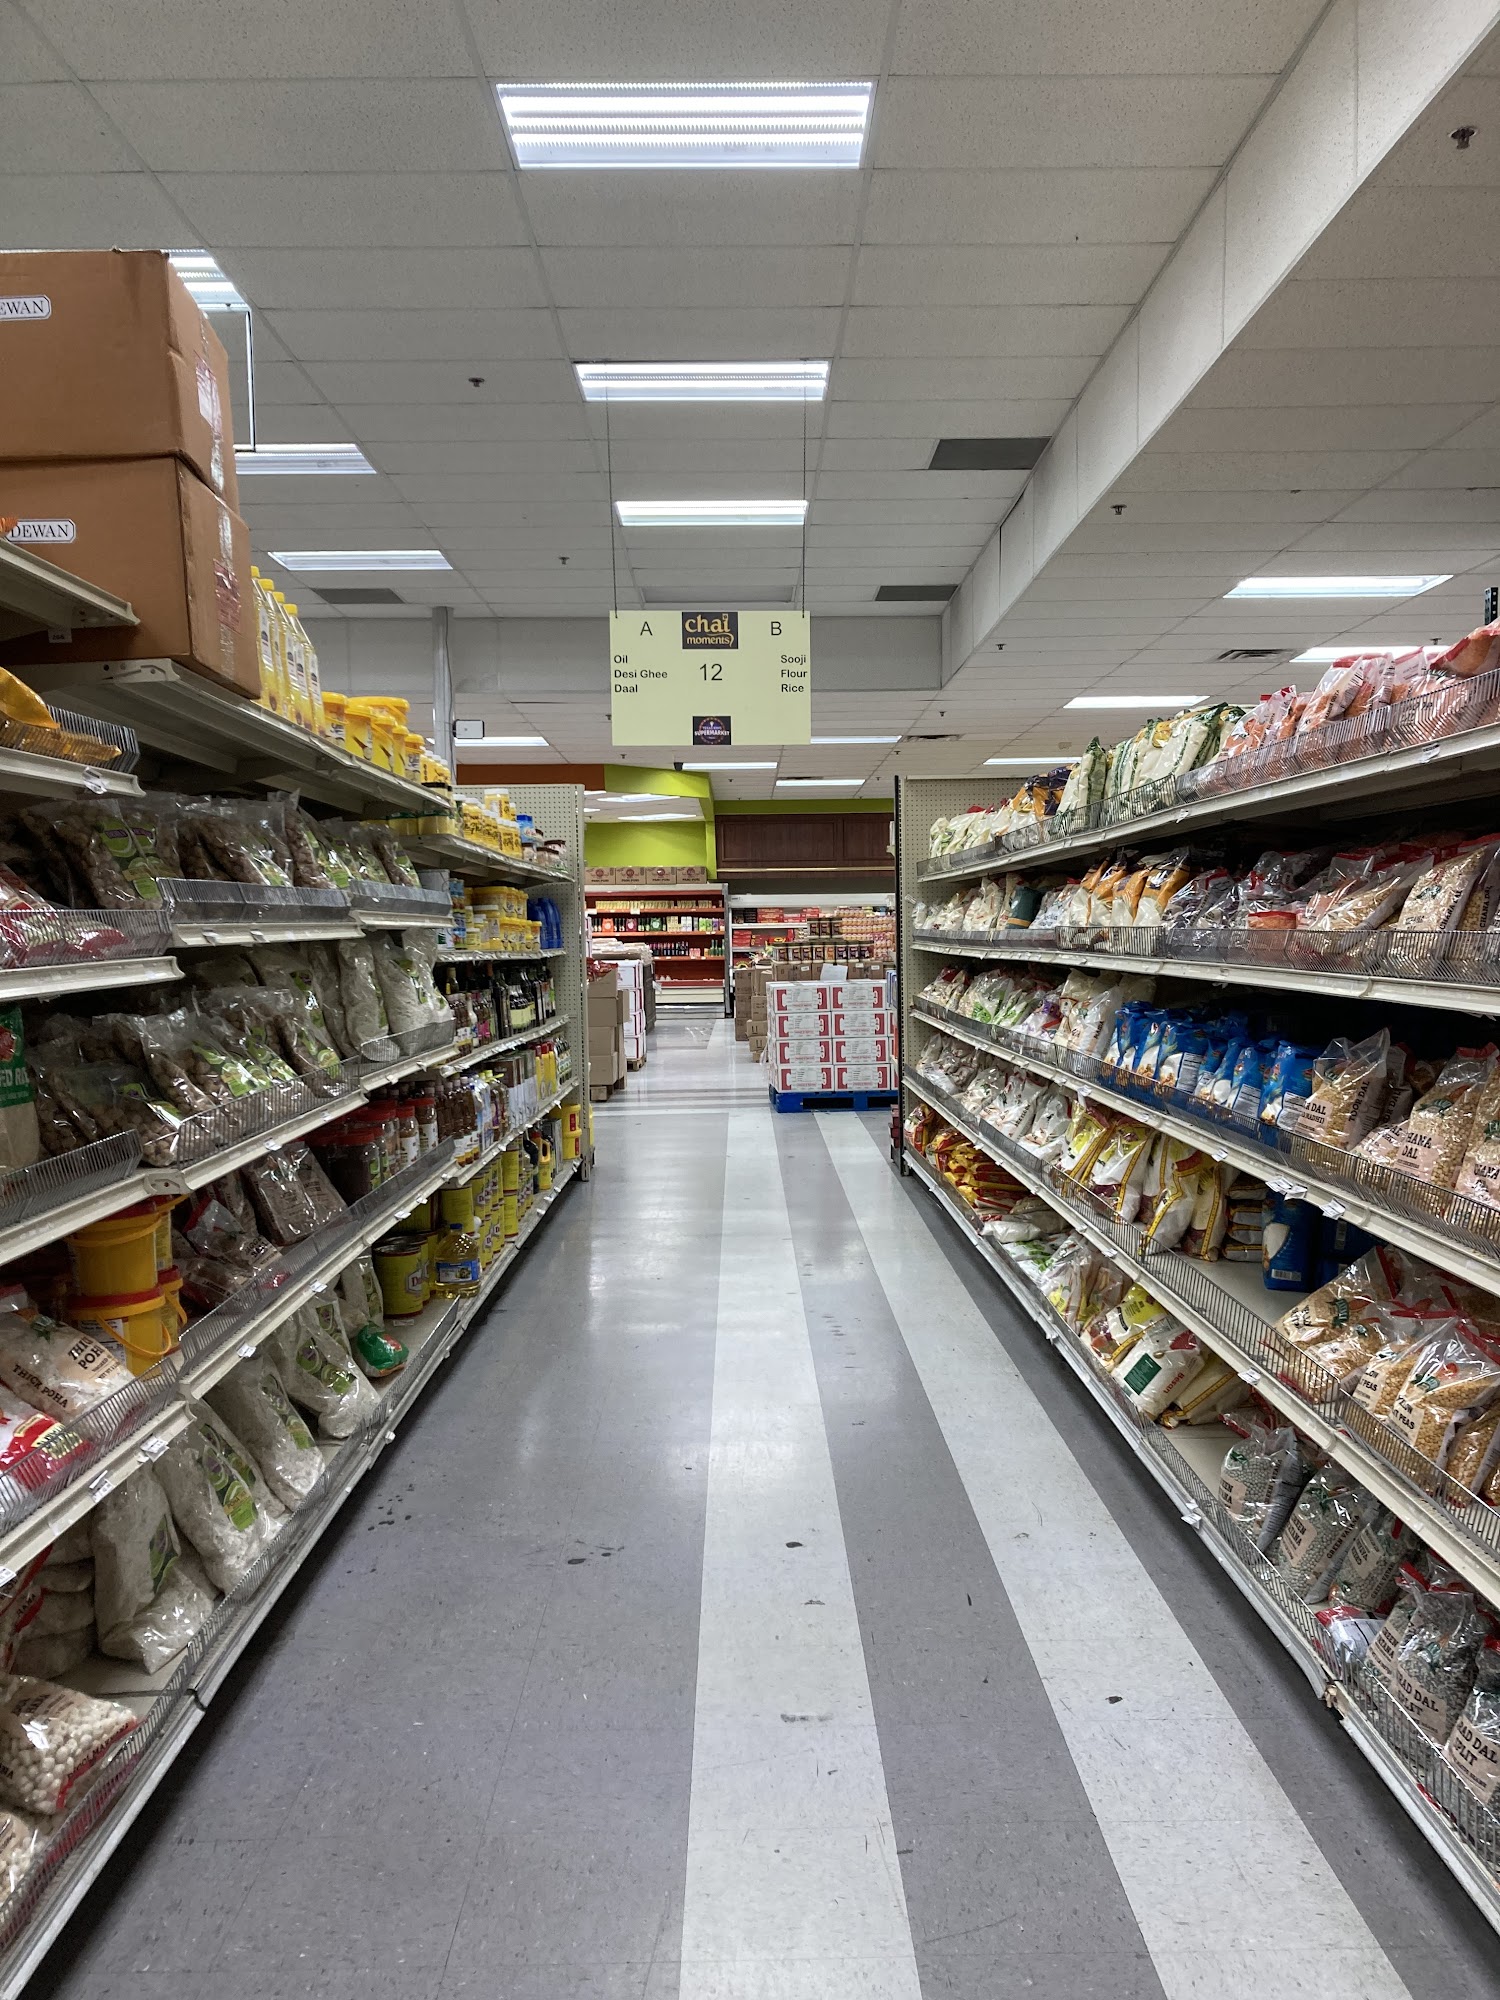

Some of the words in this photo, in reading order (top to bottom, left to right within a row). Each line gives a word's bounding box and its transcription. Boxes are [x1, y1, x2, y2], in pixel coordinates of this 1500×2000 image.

[11, 524, 68, 538] DEWAN
[640, 621, 653, 636] A
[684, 614, 731, 633] chai
[770, 621, 782, 636] B
[686, 634, 734, 646] moments
[614, 654, 628, 664] Oil
[780, 654, 807, 665] Sooji
[614, 669, 637, 678] Desi
[640, 669, 668, 678] Ghee
[699, 663, 723, 681] 12
[780, 669, 808, 678] Flour
[614, 684, 638, 693] Daal
[781, 684, 804, 693] Rice
[1348, 1100, 1362, 1122] TOOR
[1360, 1080, 1370, 1098] DAL
[1388, 1090, 1401, 1108] DAL
[1311, 1102, 1327, 1116] DAL
[1402, 1145, 1418, 1160] DAL
[12, 1364, 42, 1389] THICK
[41, 1387, 68, 1408] POHA
[1163, 1372, 1185, 1394] Besan
[1399, 1413, 1415, 1430] PEAS
[1326, 1538, 1344, 1559] GREEN
[1414, 1689, 1439, 1712] DAL
[1472, 1738, 1498, 1764] DAL
